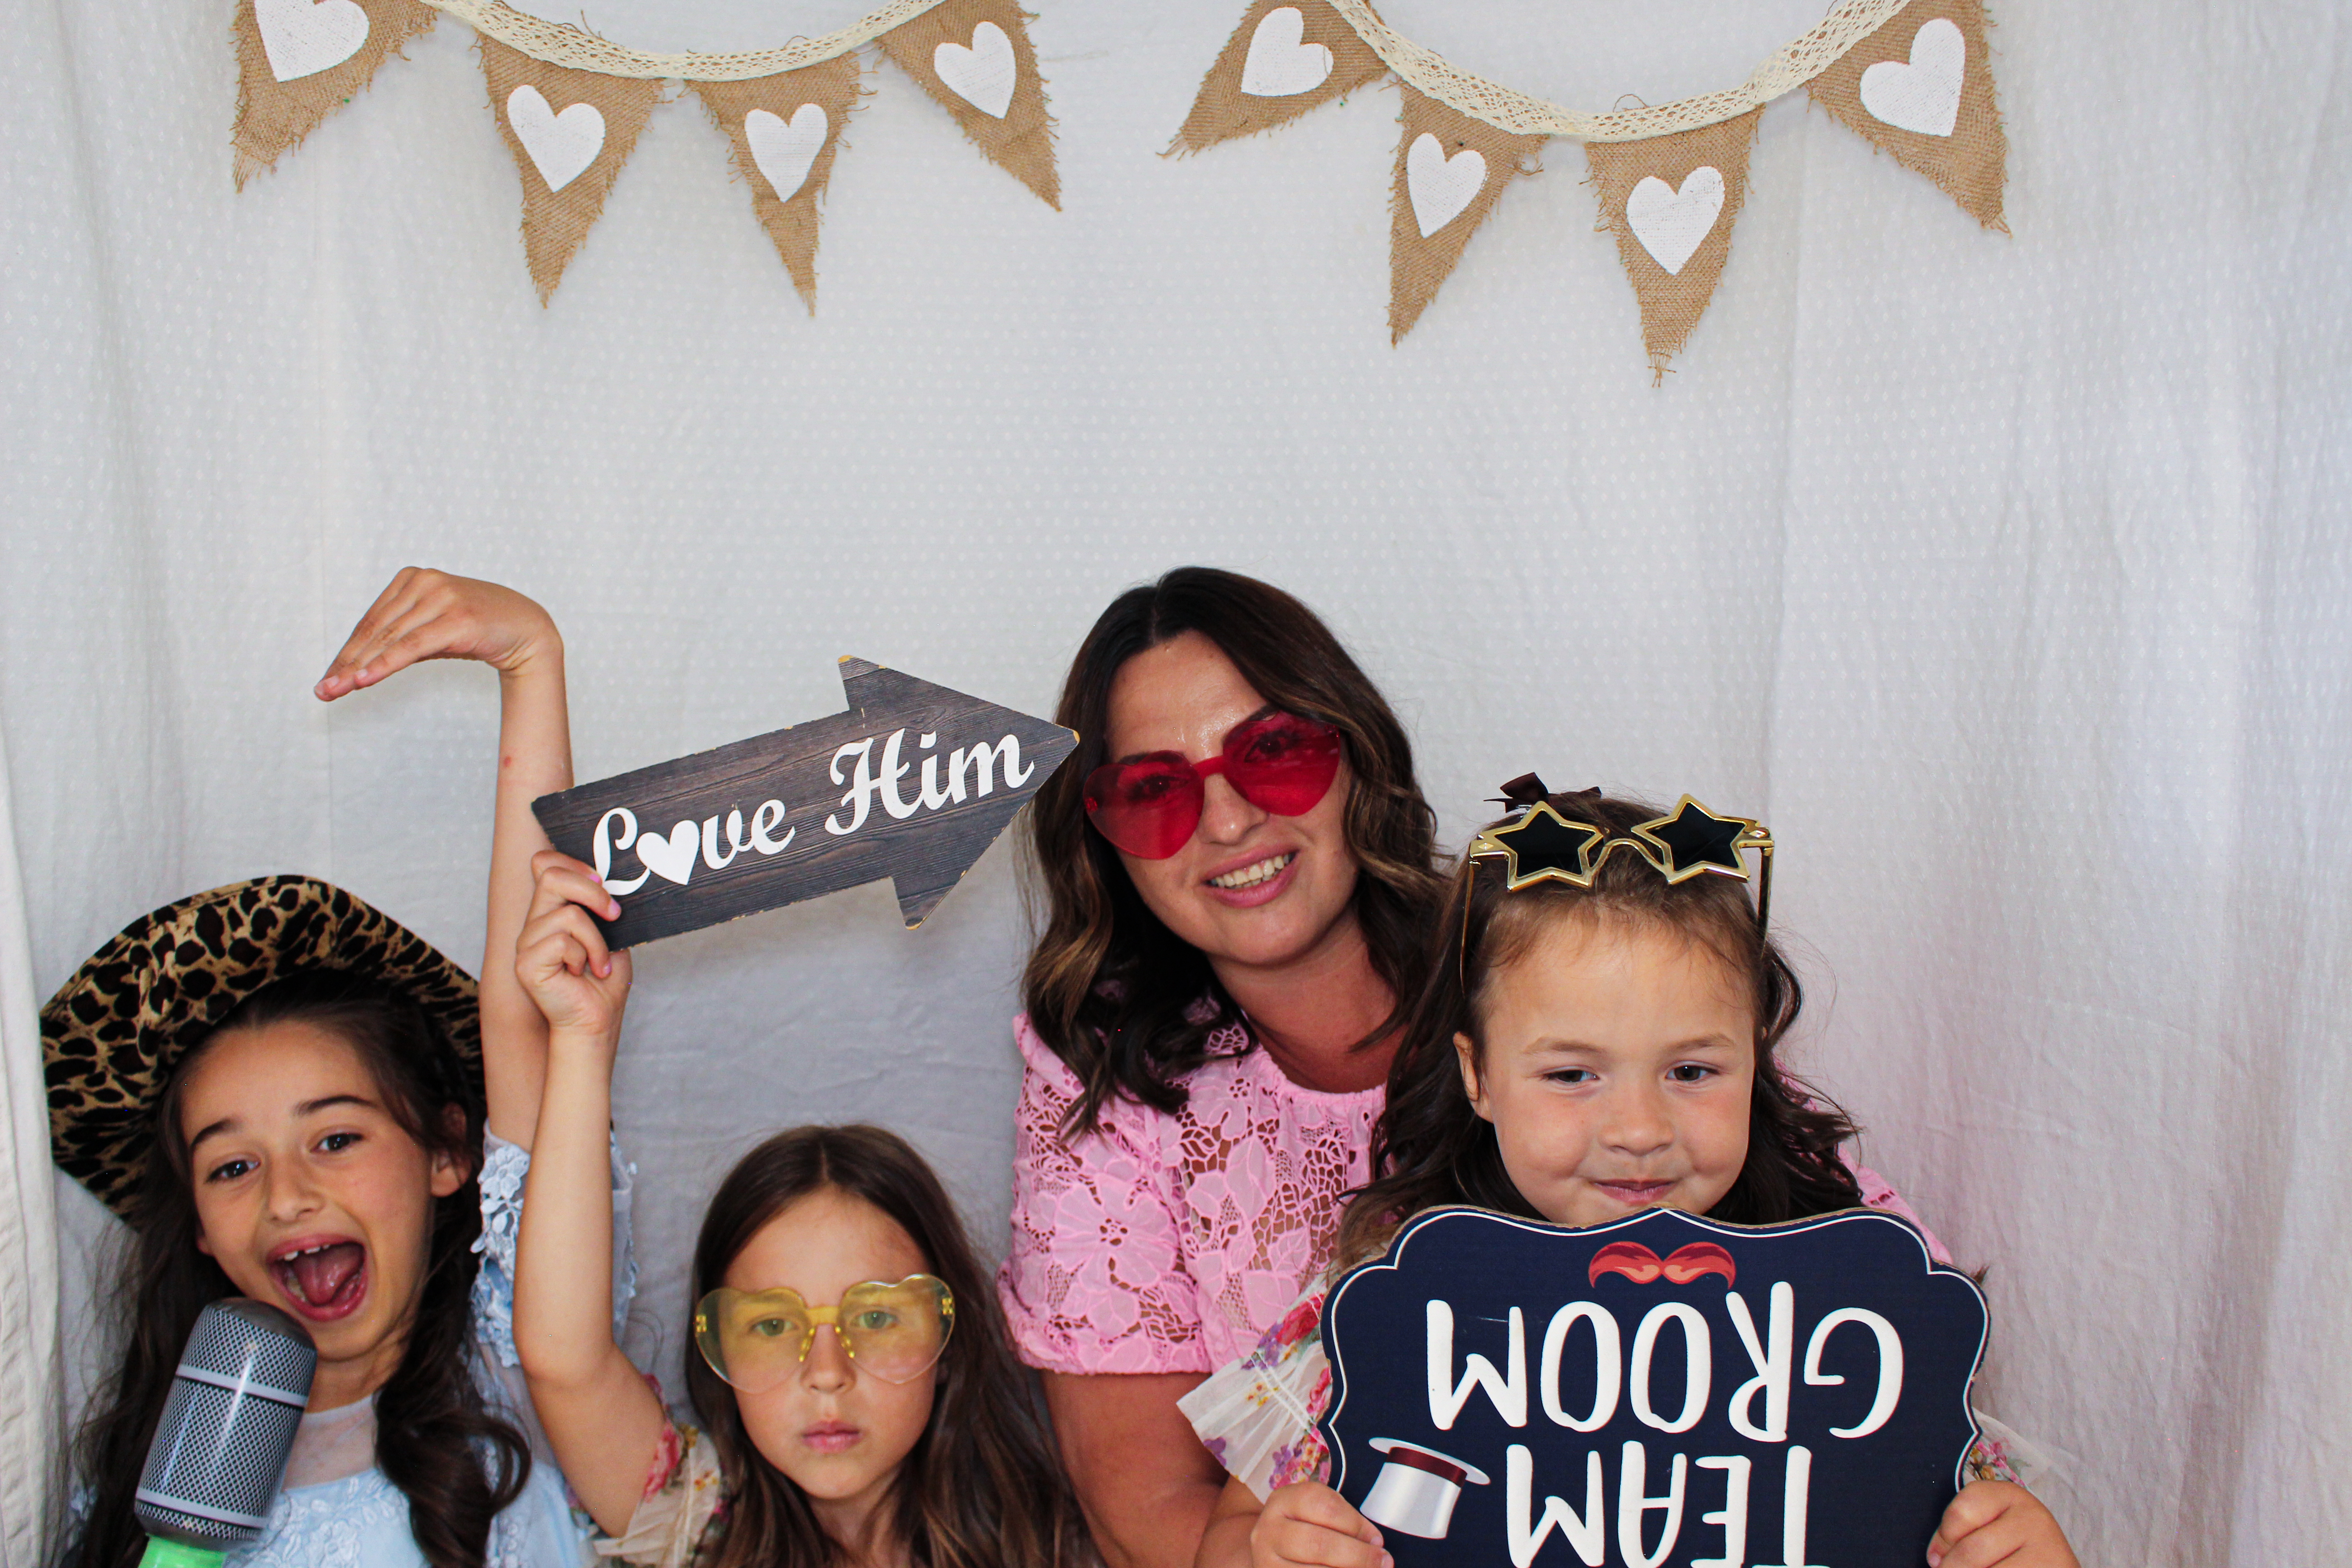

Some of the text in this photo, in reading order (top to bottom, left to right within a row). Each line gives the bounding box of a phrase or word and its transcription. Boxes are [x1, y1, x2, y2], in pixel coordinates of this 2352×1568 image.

[824, 728, 1035, 835] Him
[1426, 1282, 1904, 1441] GROOM
[1506, 1441, 1831, 1568] TEAM
